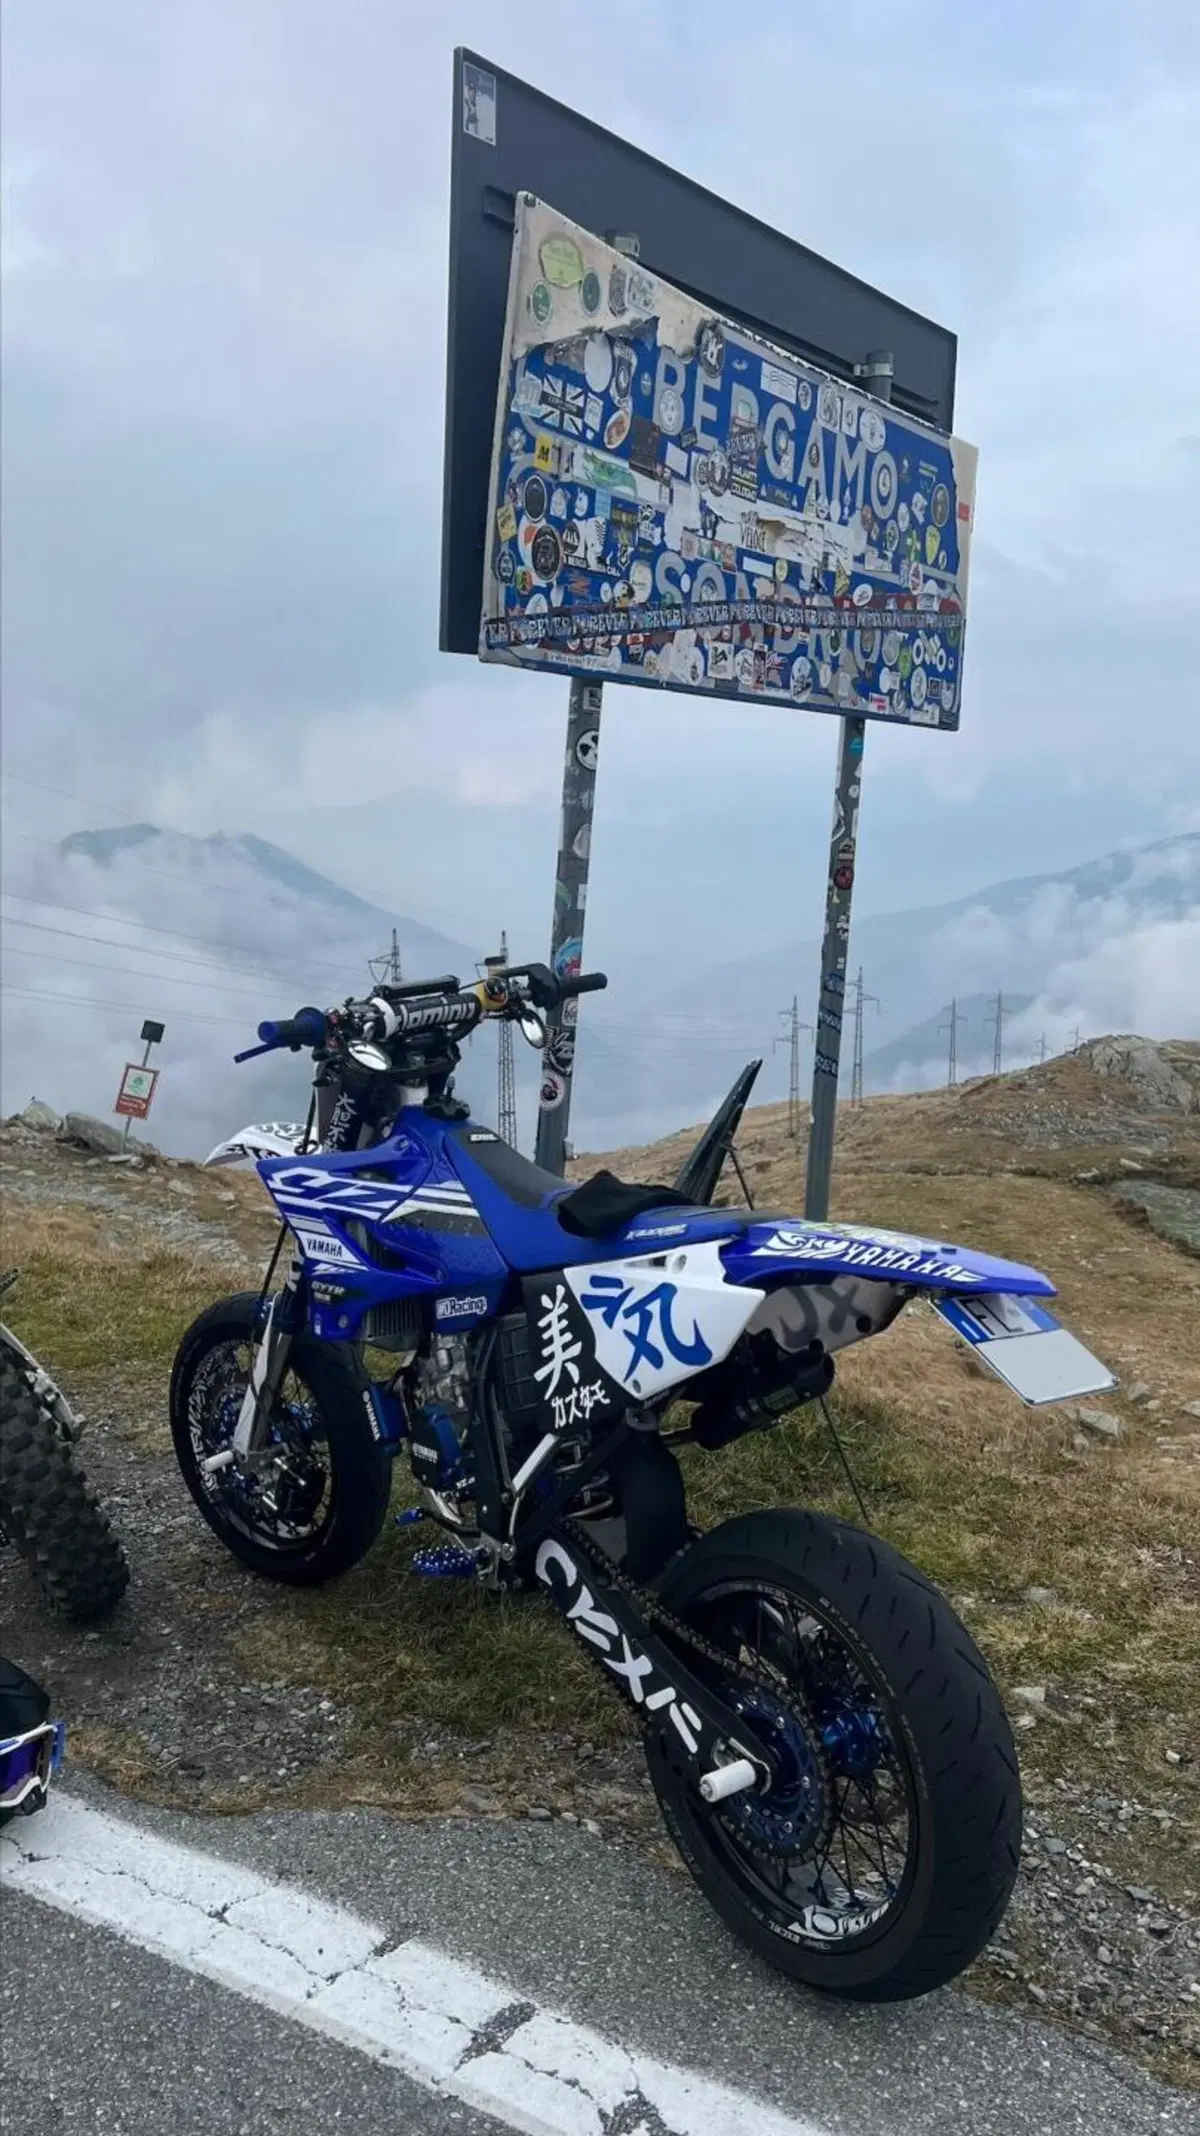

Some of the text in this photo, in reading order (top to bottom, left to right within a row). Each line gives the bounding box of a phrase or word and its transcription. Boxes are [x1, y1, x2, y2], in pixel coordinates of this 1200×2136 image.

[306, 1237, 343, 1258] YAMAHA
[840, 1242, 964, 1283] YAMAHA
[534, 1283, 583, 1401] 美
